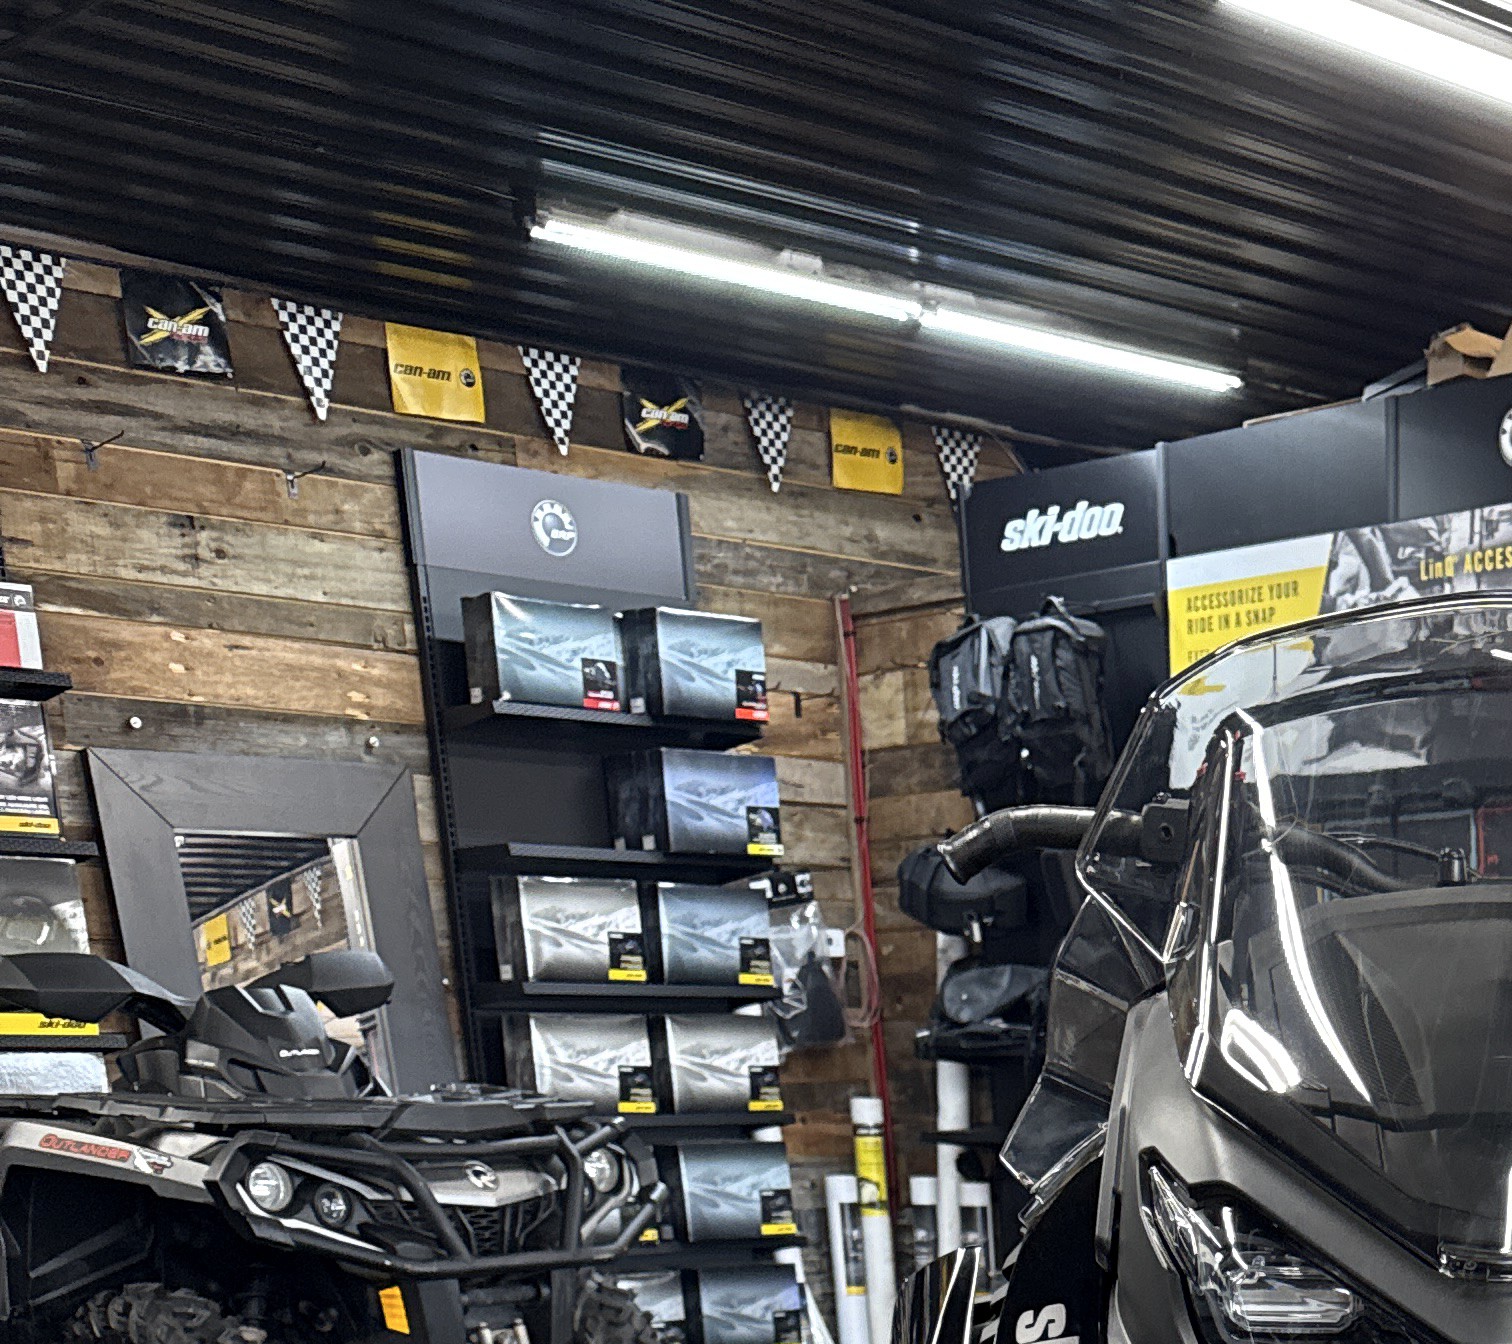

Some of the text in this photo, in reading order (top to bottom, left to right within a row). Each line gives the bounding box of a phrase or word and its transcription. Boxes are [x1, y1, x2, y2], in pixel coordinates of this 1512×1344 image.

[147, 317, 210, 337] can-am
[393, 362, 452, 382] can-am
[640, 407, 690, 425] can-am
[834, 443, 880, 459] can-am
[1001, 500, 1125, 551] ski-doo
[1186, 580, 1299, 613] ACCESSORIZE YOUR
[1186, 606, 1276, 635] RIDE IN A SNAP
[38, 1133, 132, 1163] OUTLANDER
